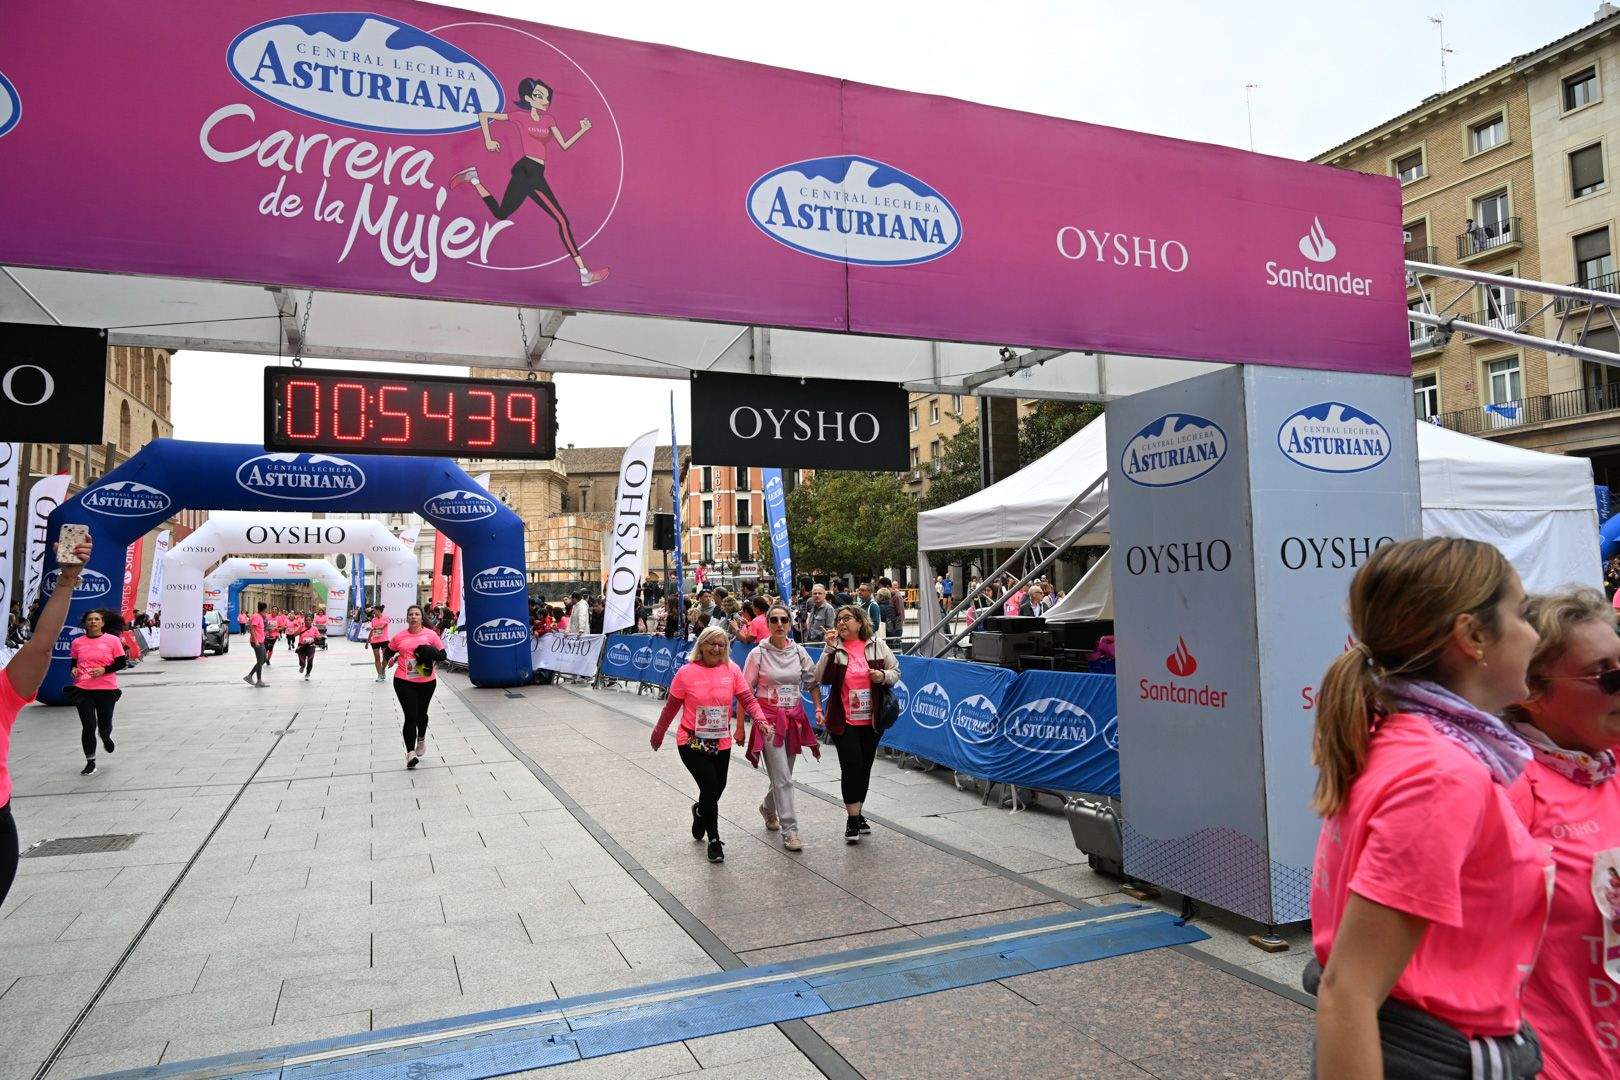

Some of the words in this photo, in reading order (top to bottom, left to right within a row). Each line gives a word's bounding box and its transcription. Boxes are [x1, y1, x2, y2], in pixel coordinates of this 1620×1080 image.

[297, 42, 384, 67] CENTRAL
[393, 59, 477, 82] LECHERA
[250, 40, 483, 115] ASTURIANA
[200, 103, 434, 190] Carrera
[800, 187, 867, 204] CENTRAL
[875, 196, 940, 214] LECHERA
[259, 176, 304, 219] de
[314, 187, 345, 224] la
[338, 184, 514, 283] Mujer
[765, 186, 948, 245] ASTURIANA
[1056, 225, 1190, 273] OYSHO
[1265, 261, 1373, 297] Santander
[729, 406, 880, 444] OYSHO
[1303, 425, 1341, 434] CENTRAL
[1343, 427, 1380, 435] LECHERA
[1141, 437, 1175, 452] CENTRAL
[1177, 430, 1214, 446] LECHERA
[1287, 427, 1384, 456] ASTURIANA
[267, 464, 309, 472] CENTRAL
[1128, 441, 1219, 474] ASTURIANA
[246, 465, 356, 489] ASTURIANA
[86, 492, 164, 509] ASTURIANA
[430, 502, 493, 515] ASTURIANA
[246, 526, 346, 544] OYSHO
[611, 459, 648, 597] OYSHO
[1126, 539, 1232, 576] OYSHO
[44, 577, 106, 592] ASIANA
[475, 578, 523, 589] ASTURIANA
[477, 630, 525, 641] ASTURIANA
[551, 637, 591, 656] OYSHO
[1140, 679, 1228, 709] Santander
[1008, 716, 1087, 742] ASTURIANA
